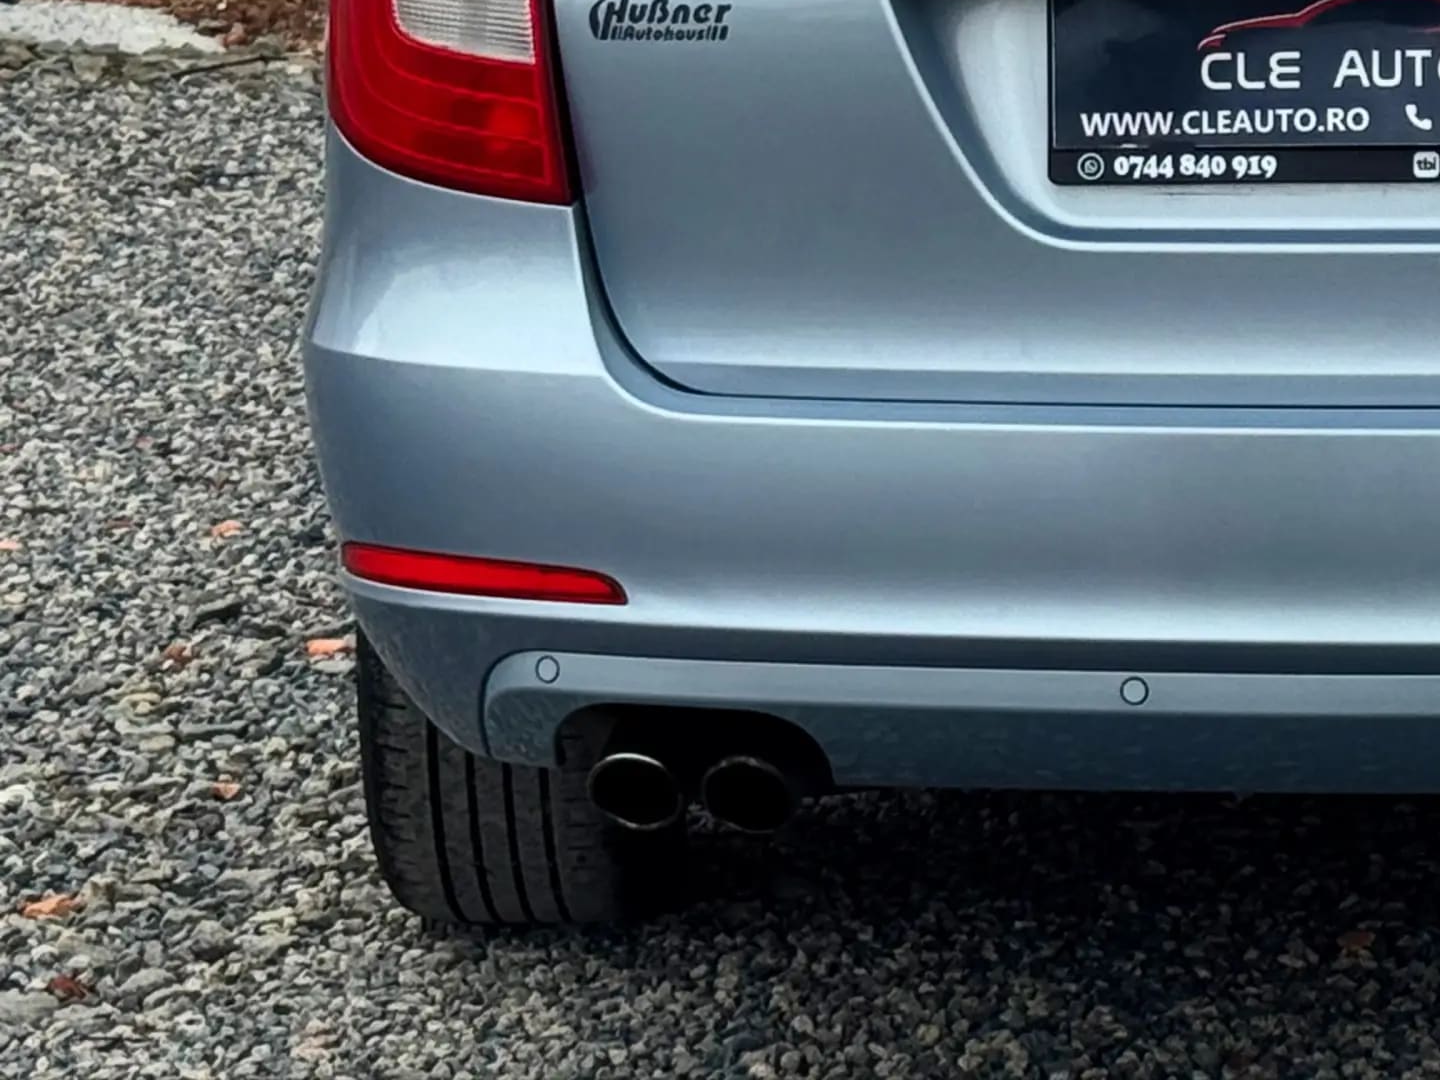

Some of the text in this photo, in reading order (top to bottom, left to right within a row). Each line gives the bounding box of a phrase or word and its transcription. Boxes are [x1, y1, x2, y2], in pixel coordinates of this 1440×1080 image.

[1201, 51, 1301, 90] CLE
[1080, 107, 1370, 136] WWW.CLEAUTO.RO
[1113, 153, 1277, 179] 0744 840 919
